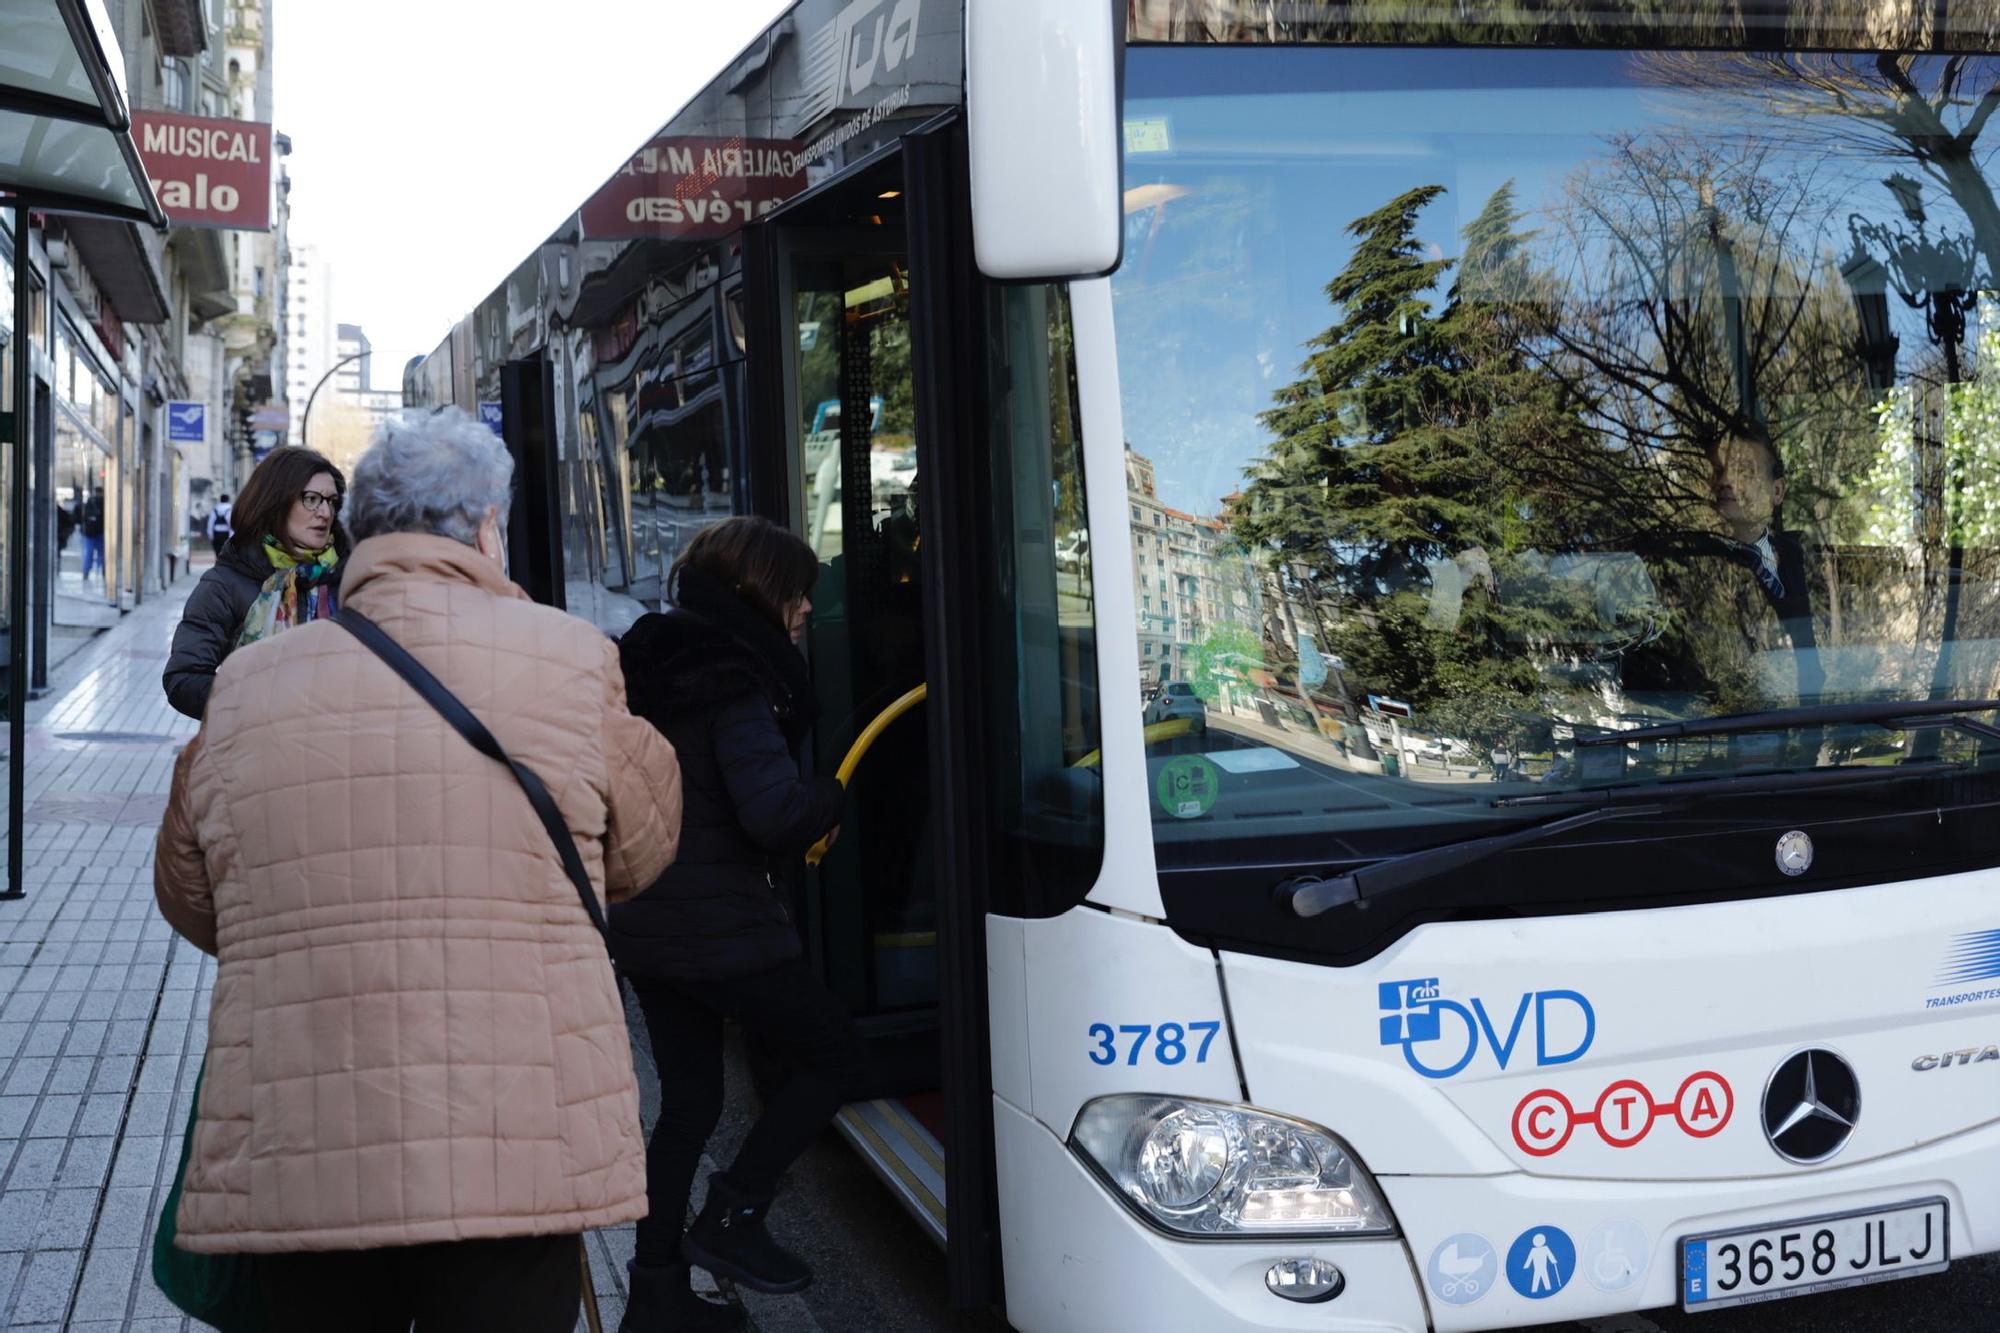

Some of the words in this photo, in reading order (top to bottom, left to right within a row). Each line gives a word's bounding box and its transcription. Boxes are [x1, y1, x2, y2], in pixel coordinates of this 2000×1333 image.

[143, 122, 261, 164] MUSICAL
[793, 132, 835, 173] TRANSPORTES
[835, 116, 861, 147] UNIDOS
[861, 108, 871, 131] DE
[872, 83, 910, 124] ASTURIAS
[1926, 988, 2000, 1009] TRANSPORTES
[1088, 1020, 1221, 1067] 3787
[1399, 987, 1596, 1080] OVD
[1716, 1228, 1837, 1291] 3658
[1849, 1212, 1932, 1270] JLJ
[1690, 1278, 1702, 1293] E
